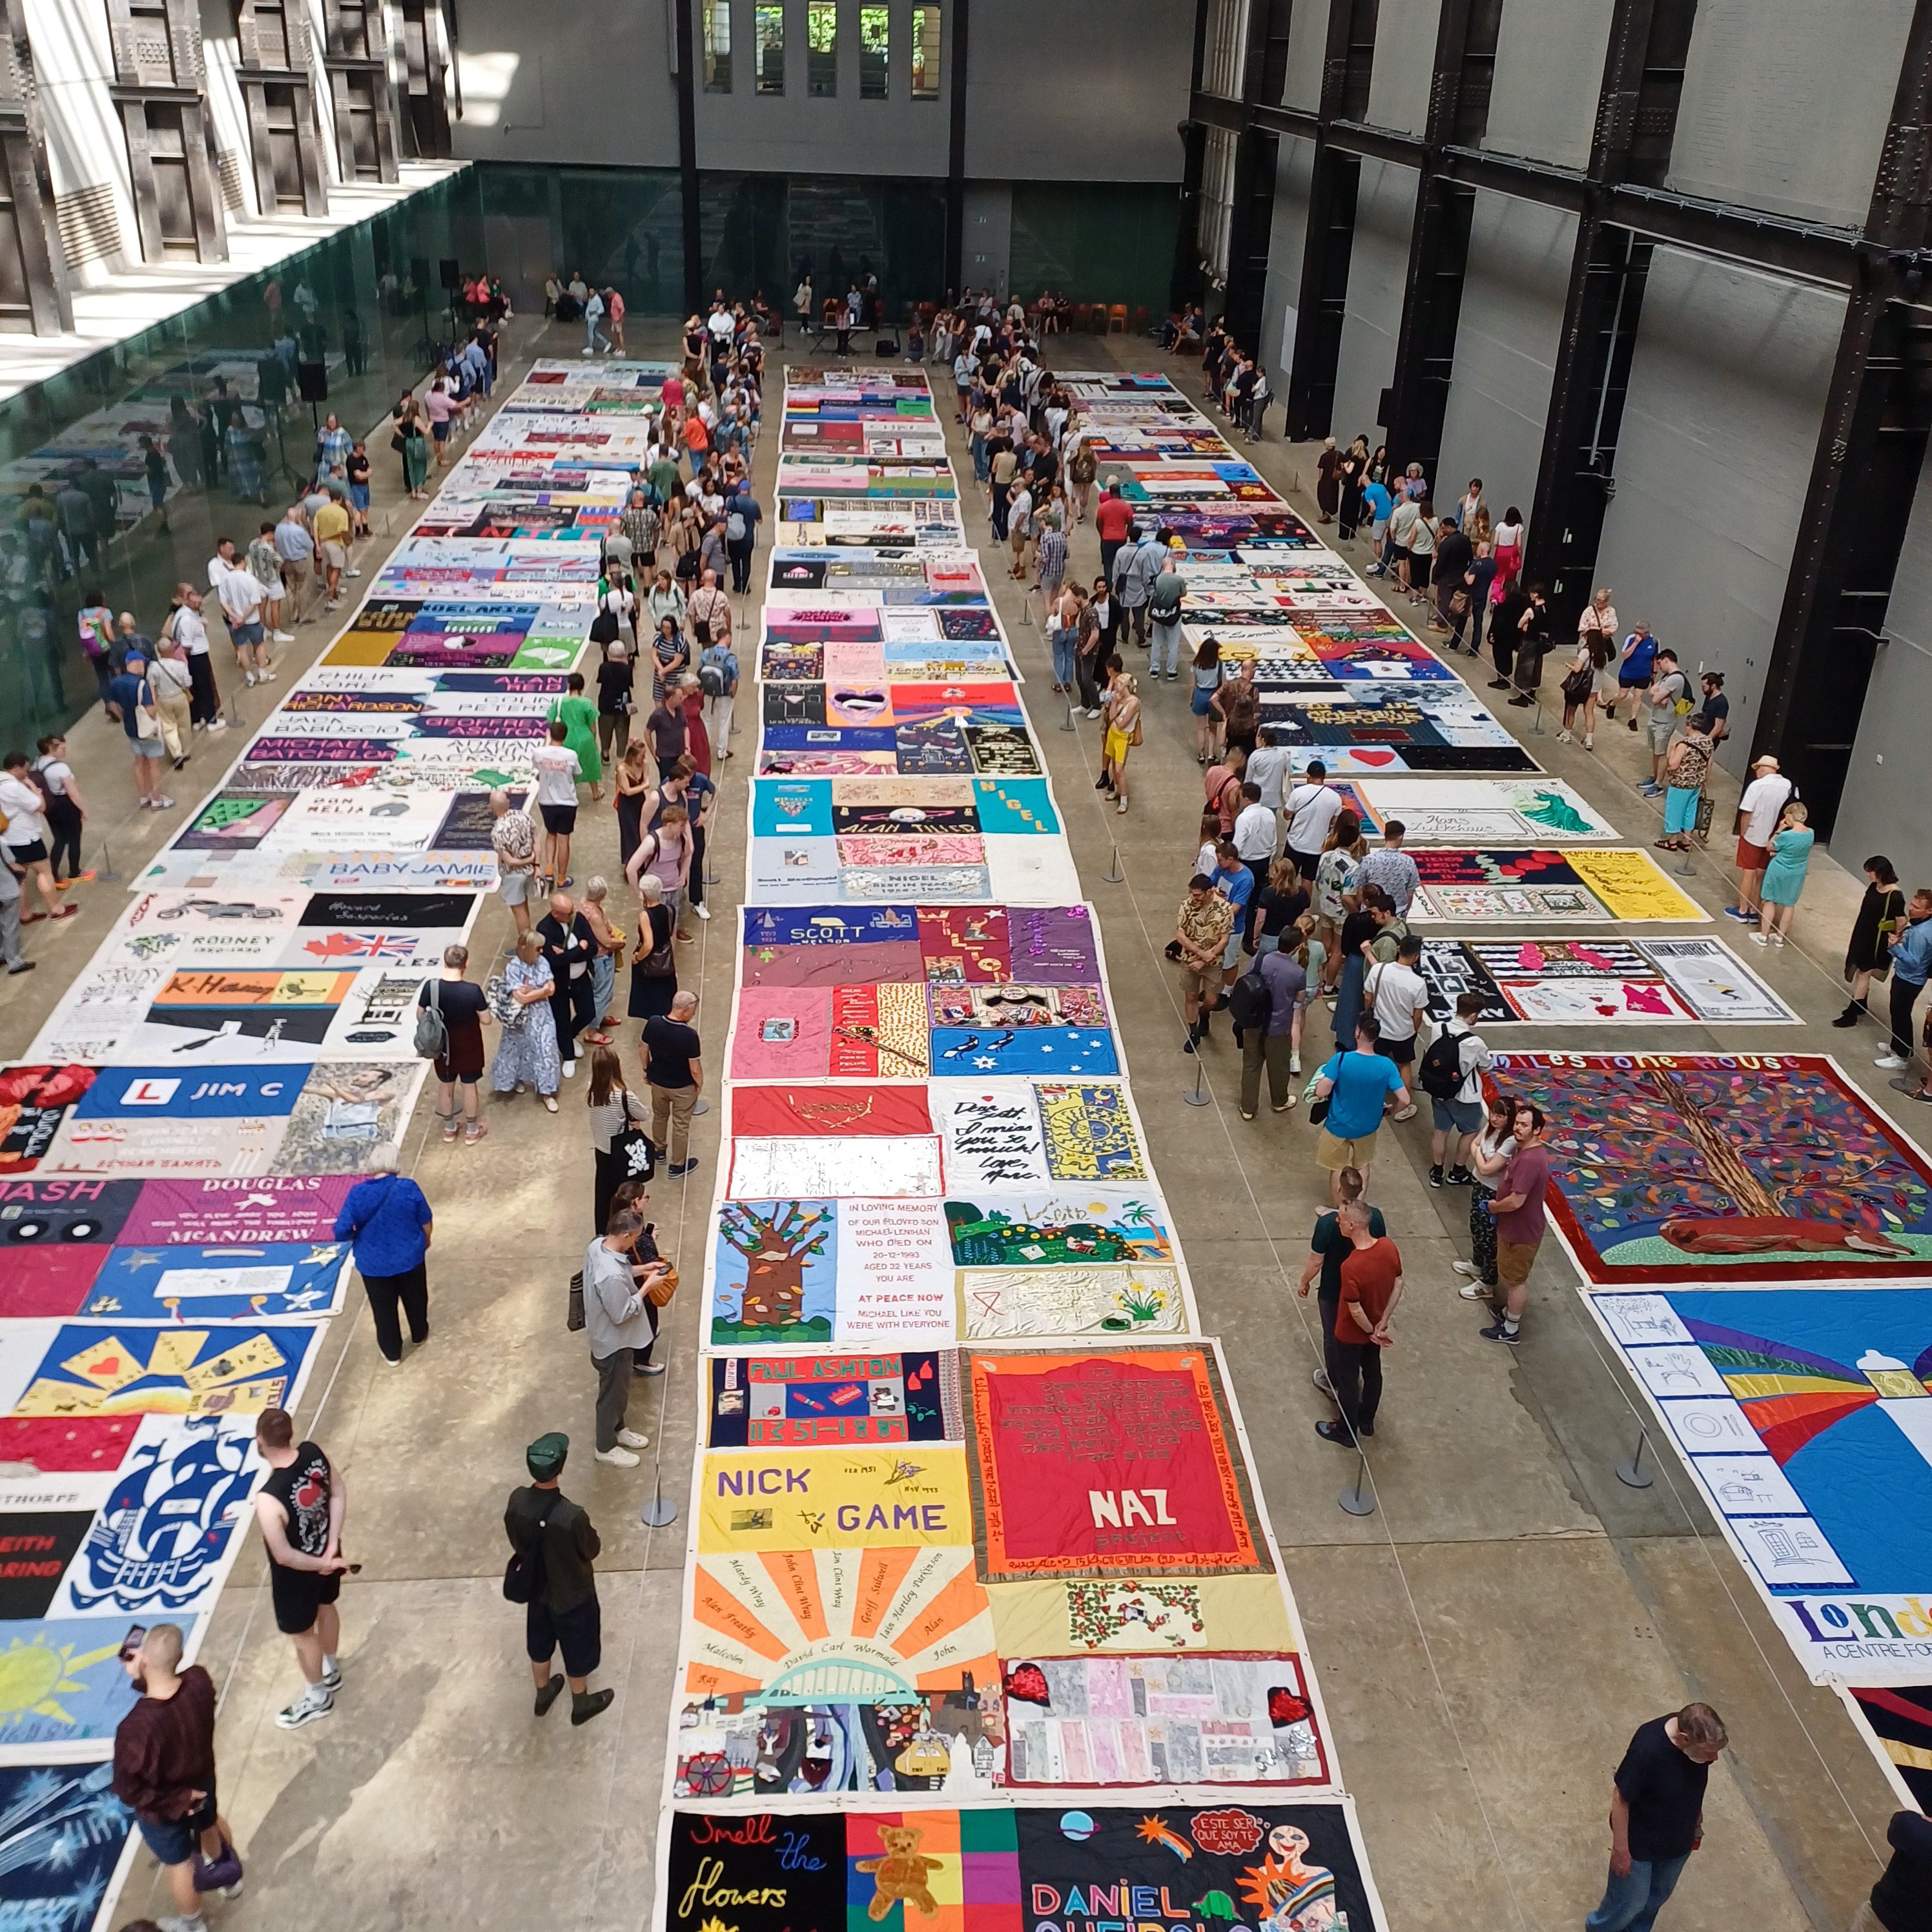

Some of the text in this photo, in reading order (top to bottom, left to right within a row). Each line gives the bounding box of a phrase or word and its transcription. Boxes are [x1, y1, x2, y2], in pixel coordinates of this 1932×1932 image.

[284, 703, 424, 711] RICHARDSON
[426, 717, 548, 728] GEOFFREY
[447, 727, 549, 736] ASHTON
[258, 739, 374, 749] MICHAEL
[250, 749, 398, 759] BATCHELOR
[980, 781, 1049, 832] NIGEL
[839, 824, 900, 833] ALAN
[329, 863, 495, 876] BABY JAMIE
[193, 936, 274, 945] RODNEY
[790, 926, 865, 940] SCOTT
[395, 957, 440, 967] LES
[136, 1083, 159, 1100] L
[190, 1082, 283, 1100] JIM C
[954, 1102, 999, 1115] Dear
[980, 1122, 1033, 1134] miss
[954, 1135, 1027, 1151] you so
[202, 1177, 322, 1191] DOUGLAS
[898, 1204, 938, 1212] MEMORY
[167, 1228, 314, 1244] McANDREW
[903, 1320, 951, 1328] EVERYONE
[750, 1360, 806, 1380] PAUL
[812, 1357, 902, 1377] ASHTON
[718, 1468, 811, 1497] NICK
[0, 1493, 78, 1505] THORPE
[1089, 1488, 1177, 1528] NAZ
[837, 1505, 948, 1532] GAME
[0, 1536, 56, 1552] EITH
[0, 1560, 62, 1577] RING
[730, 1559, 765, 1608] Mandy Wray
[880, 1552, 943, 1639] Iain Hartley Parkinson
[702, 1597, 723, 1614] Alan
[799, 1596, 812, 1620] Wray
[861, 1600, 878, 1623] Geoff
[925, 1617, 943, 1636] Alan
[1783, 1598, 1932, 1642] Lond
[703, 1643, 744, 1665] Malcolm
[783, 1642, 899, 1670] David Carl Wormald
[933, 1645, 957, 1661] John
[1824, 1646, 1836, 1659] A
[1840, 1643, 1906, 1658] CENTRE
[697, 1674, 719, 1686] Ray
[691, 1815, 777, 1845] Smell
[1200, 1818, 1253, 1829] ESTE SER
[1197, 1830, 1254, 1840] QUE SOY TE
[775, 1832, 828, 1871] the
[1217, 1841, 1241, 1850] AMA
[678, 1857, 787, 1918] flowers
